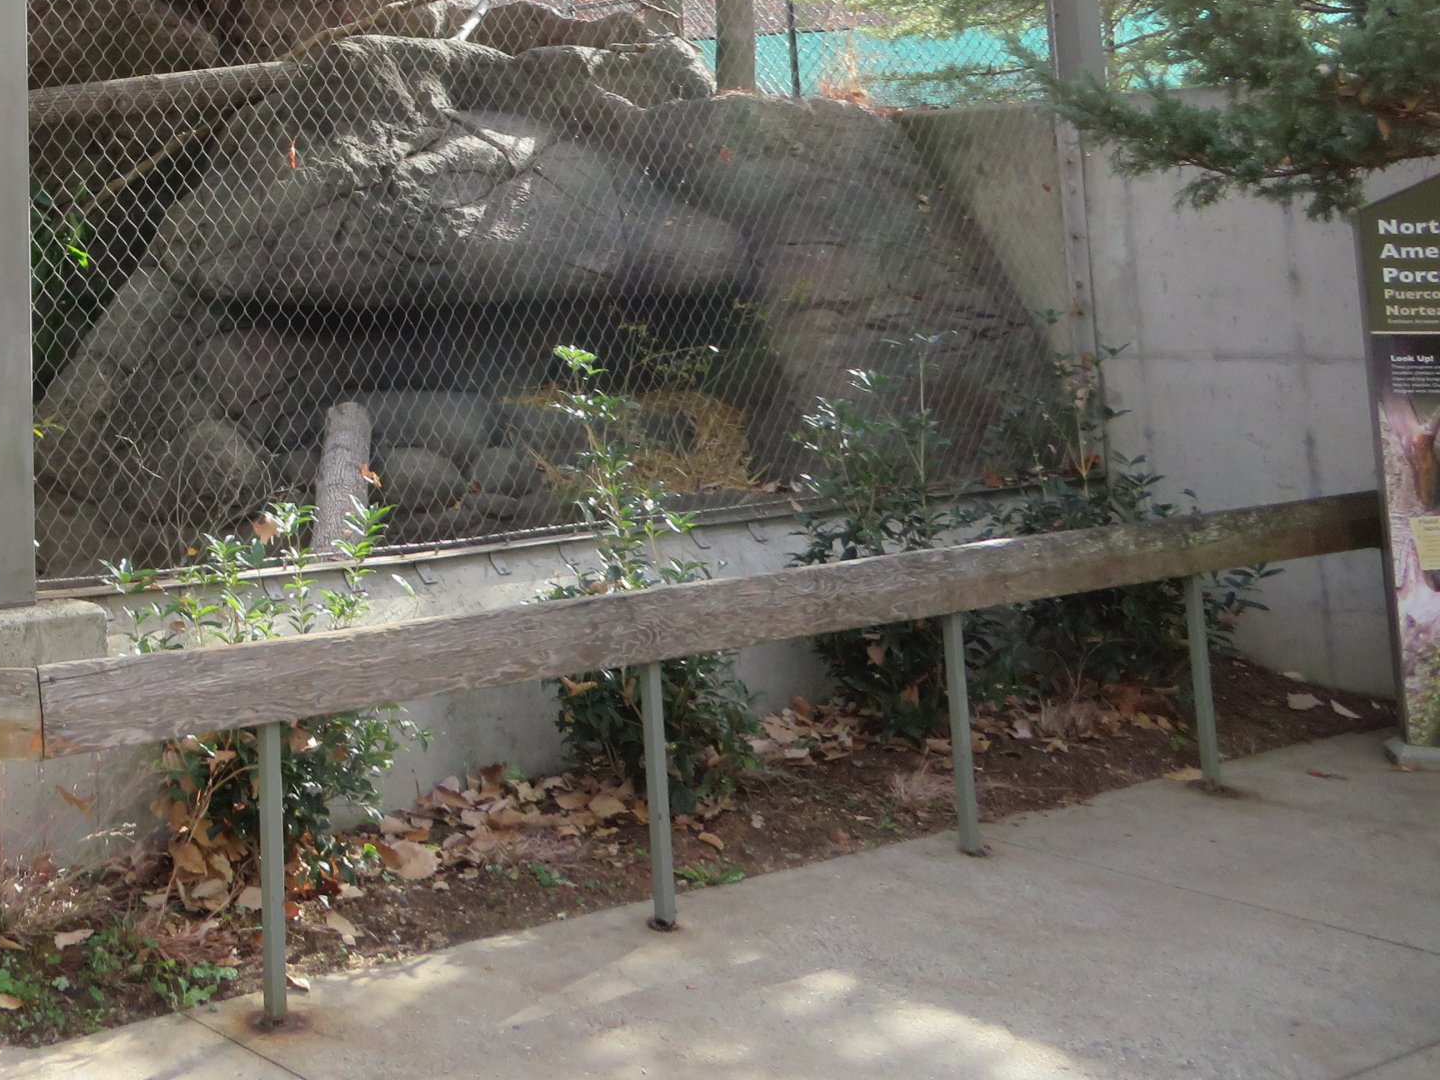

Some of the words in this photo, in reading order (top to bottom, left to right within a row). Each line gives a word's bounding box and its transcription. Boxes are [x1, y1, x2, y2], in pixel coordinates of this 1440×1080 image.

[1380, 243, 1440, 259] Ame
[1382, 267, 1440, 283] Porc
[1384, 288, 1440, 300] Puerco
[1390, 354, 1415, 362] Look
[1416, 354, 1435, 364] Up!
